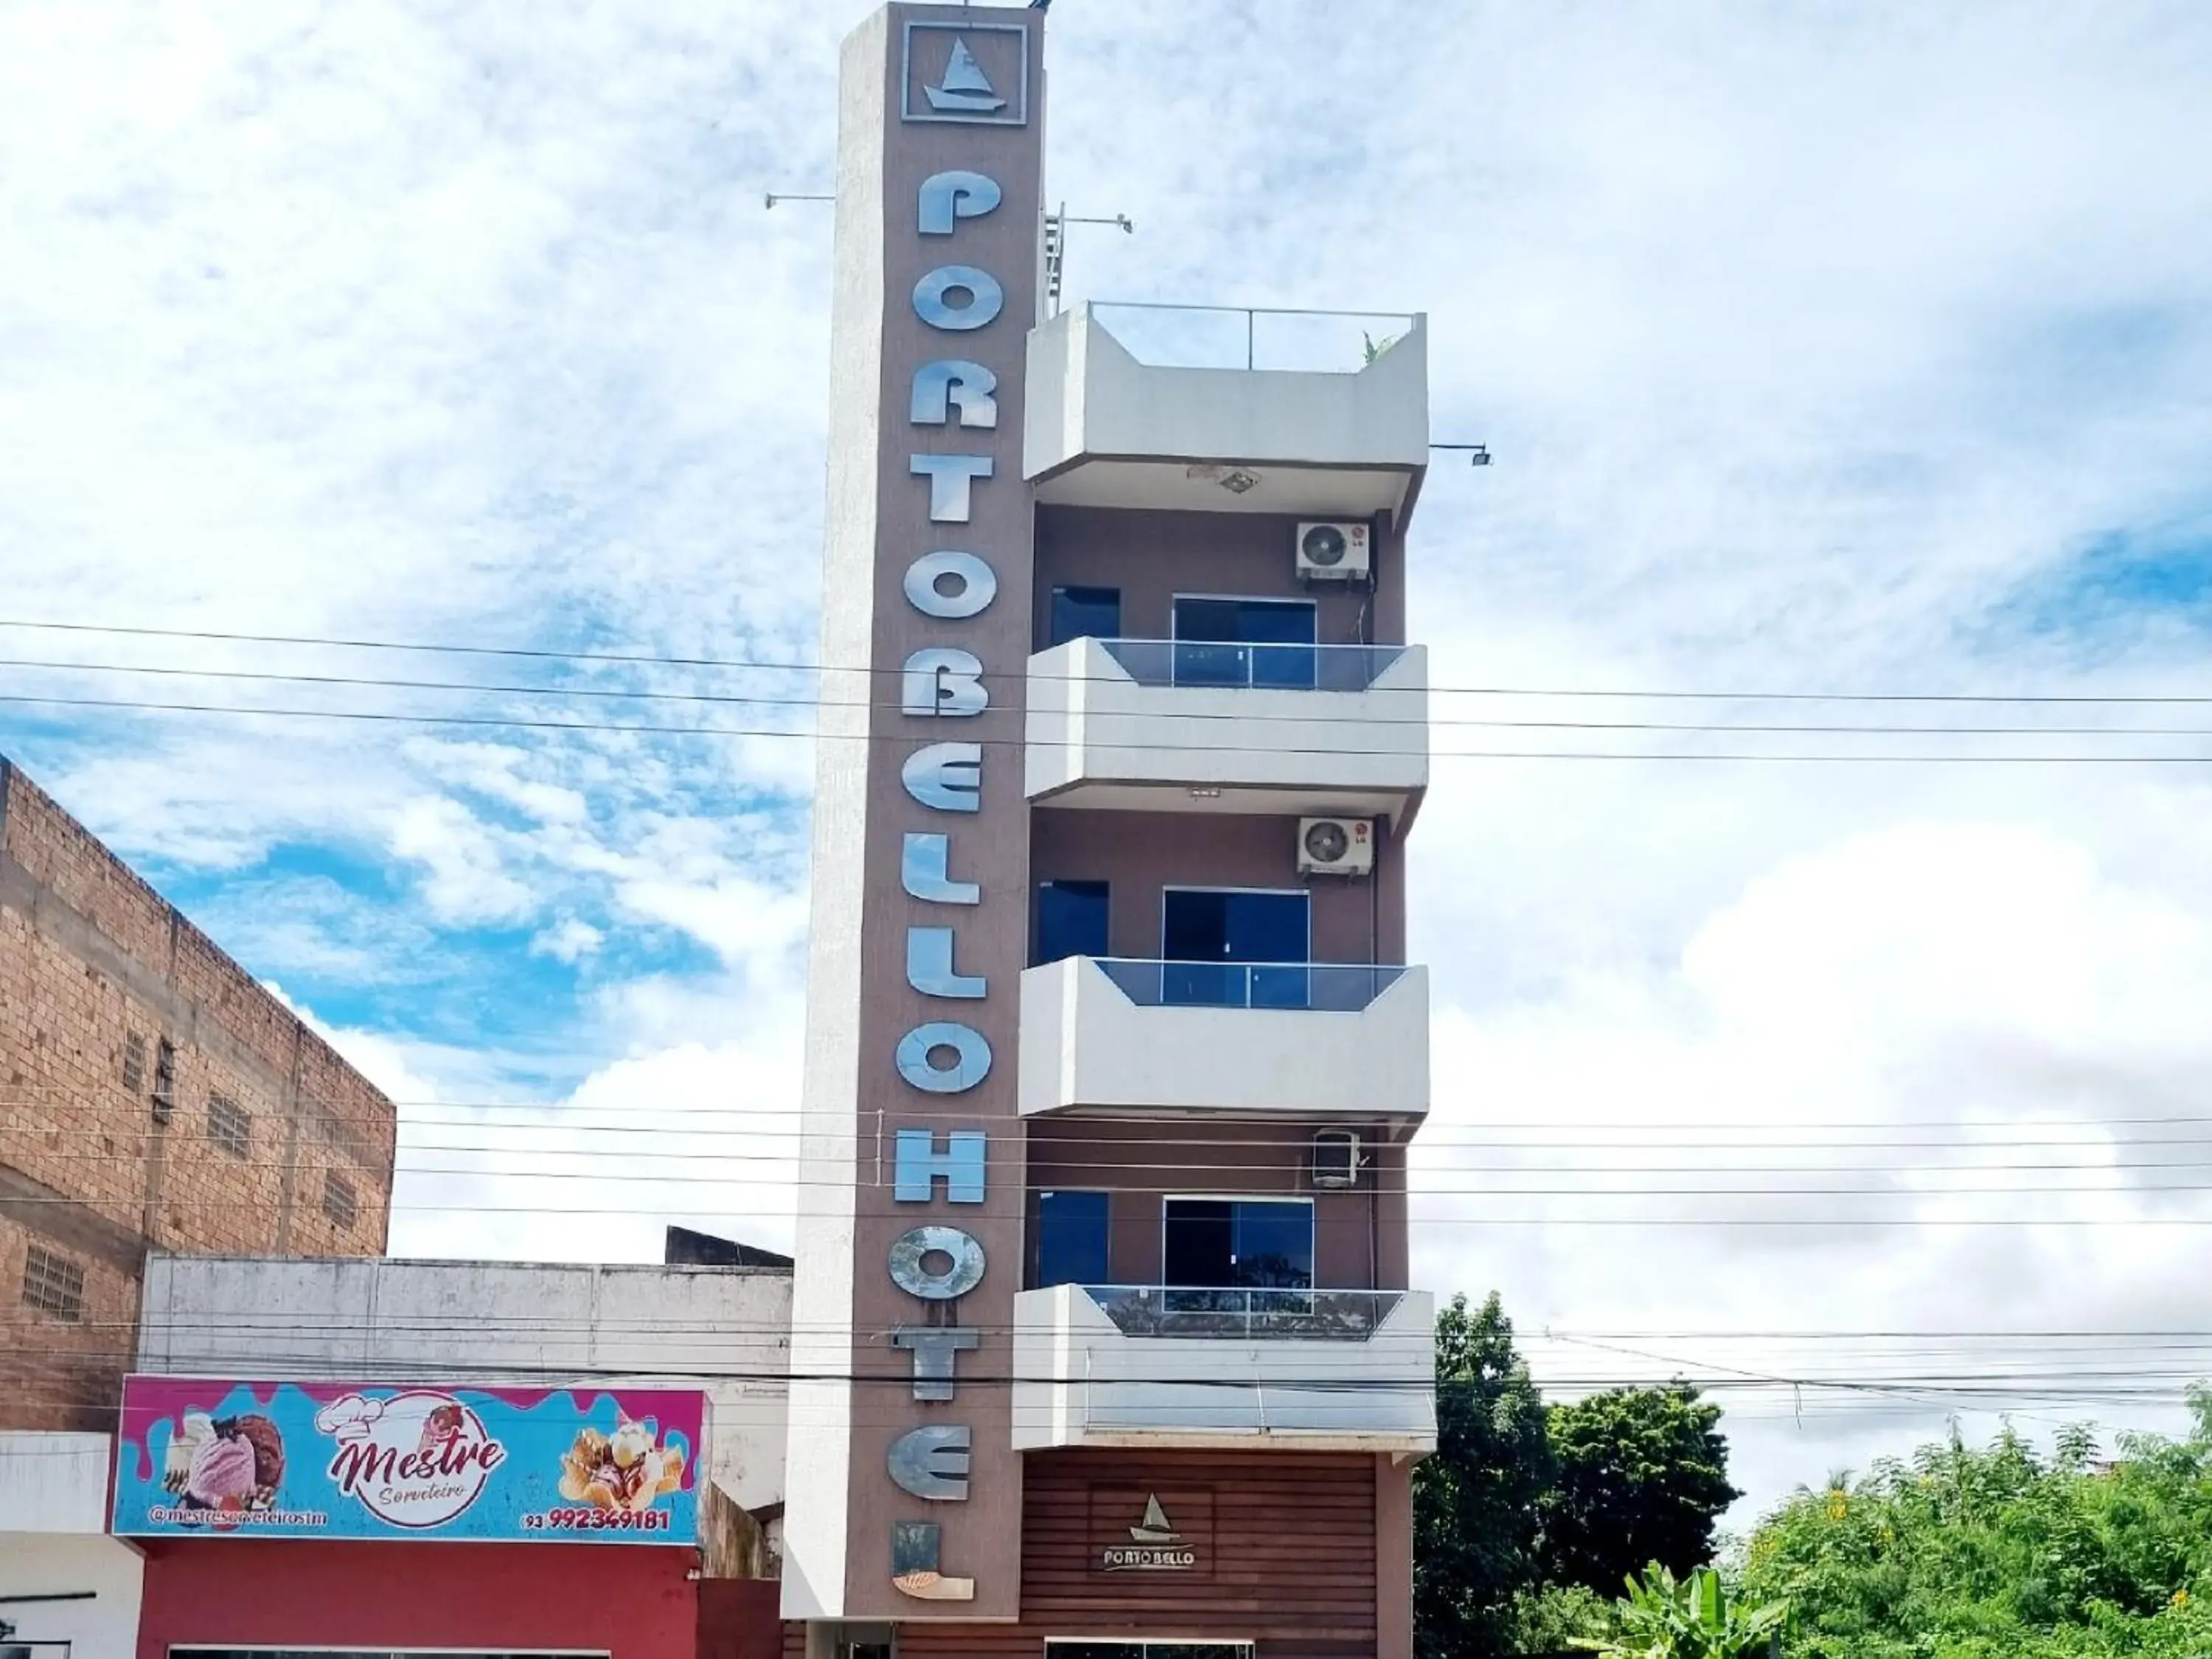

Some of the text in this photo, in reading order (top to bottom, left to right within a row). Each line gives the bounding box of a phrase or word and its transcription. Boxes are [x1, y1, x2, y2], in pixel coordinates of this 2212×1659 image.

[887, 1129, 987, 1600] HOTEL
[331, 1425, 504, 1492] Mestre
[378, 1481, 466, 1505] Sorveteiro
[549, 1508, 669, 1529] 992349181
